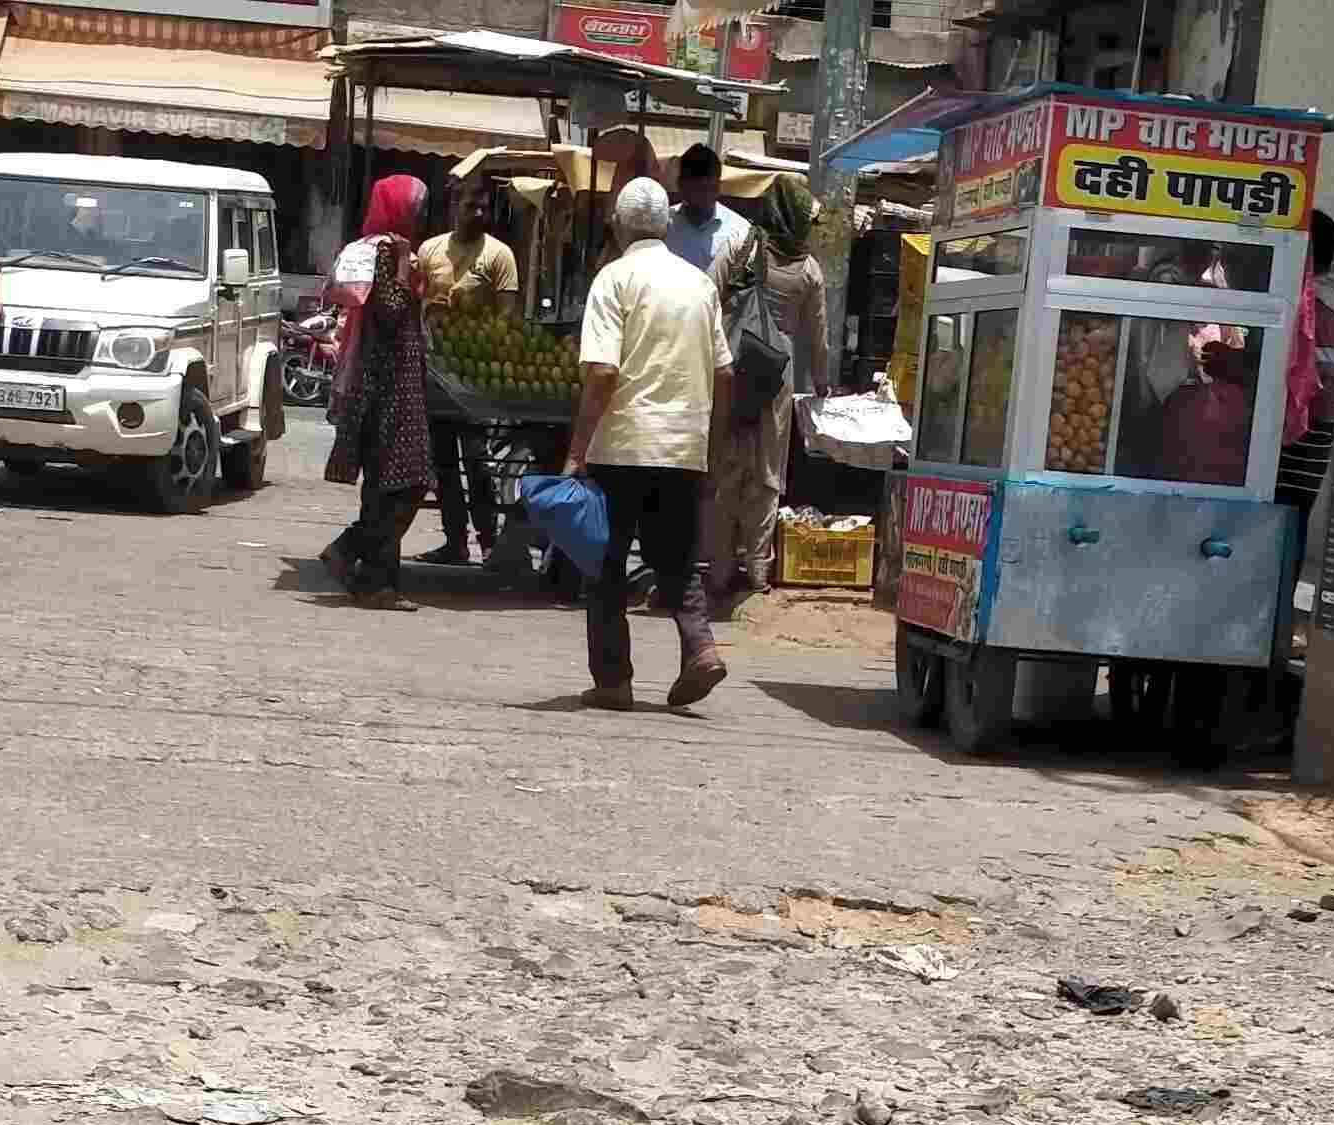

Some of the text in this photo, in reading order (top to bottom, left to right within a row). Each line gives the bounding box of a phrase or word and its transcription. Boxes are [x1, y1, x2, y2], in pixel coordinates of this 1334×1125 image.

[41, 102, 250, 136] MAHAVIR SWEETS
[1066, 105, 1308, 162] MP चाट भण्डार
[1073, 155, 1155, 201] दही
